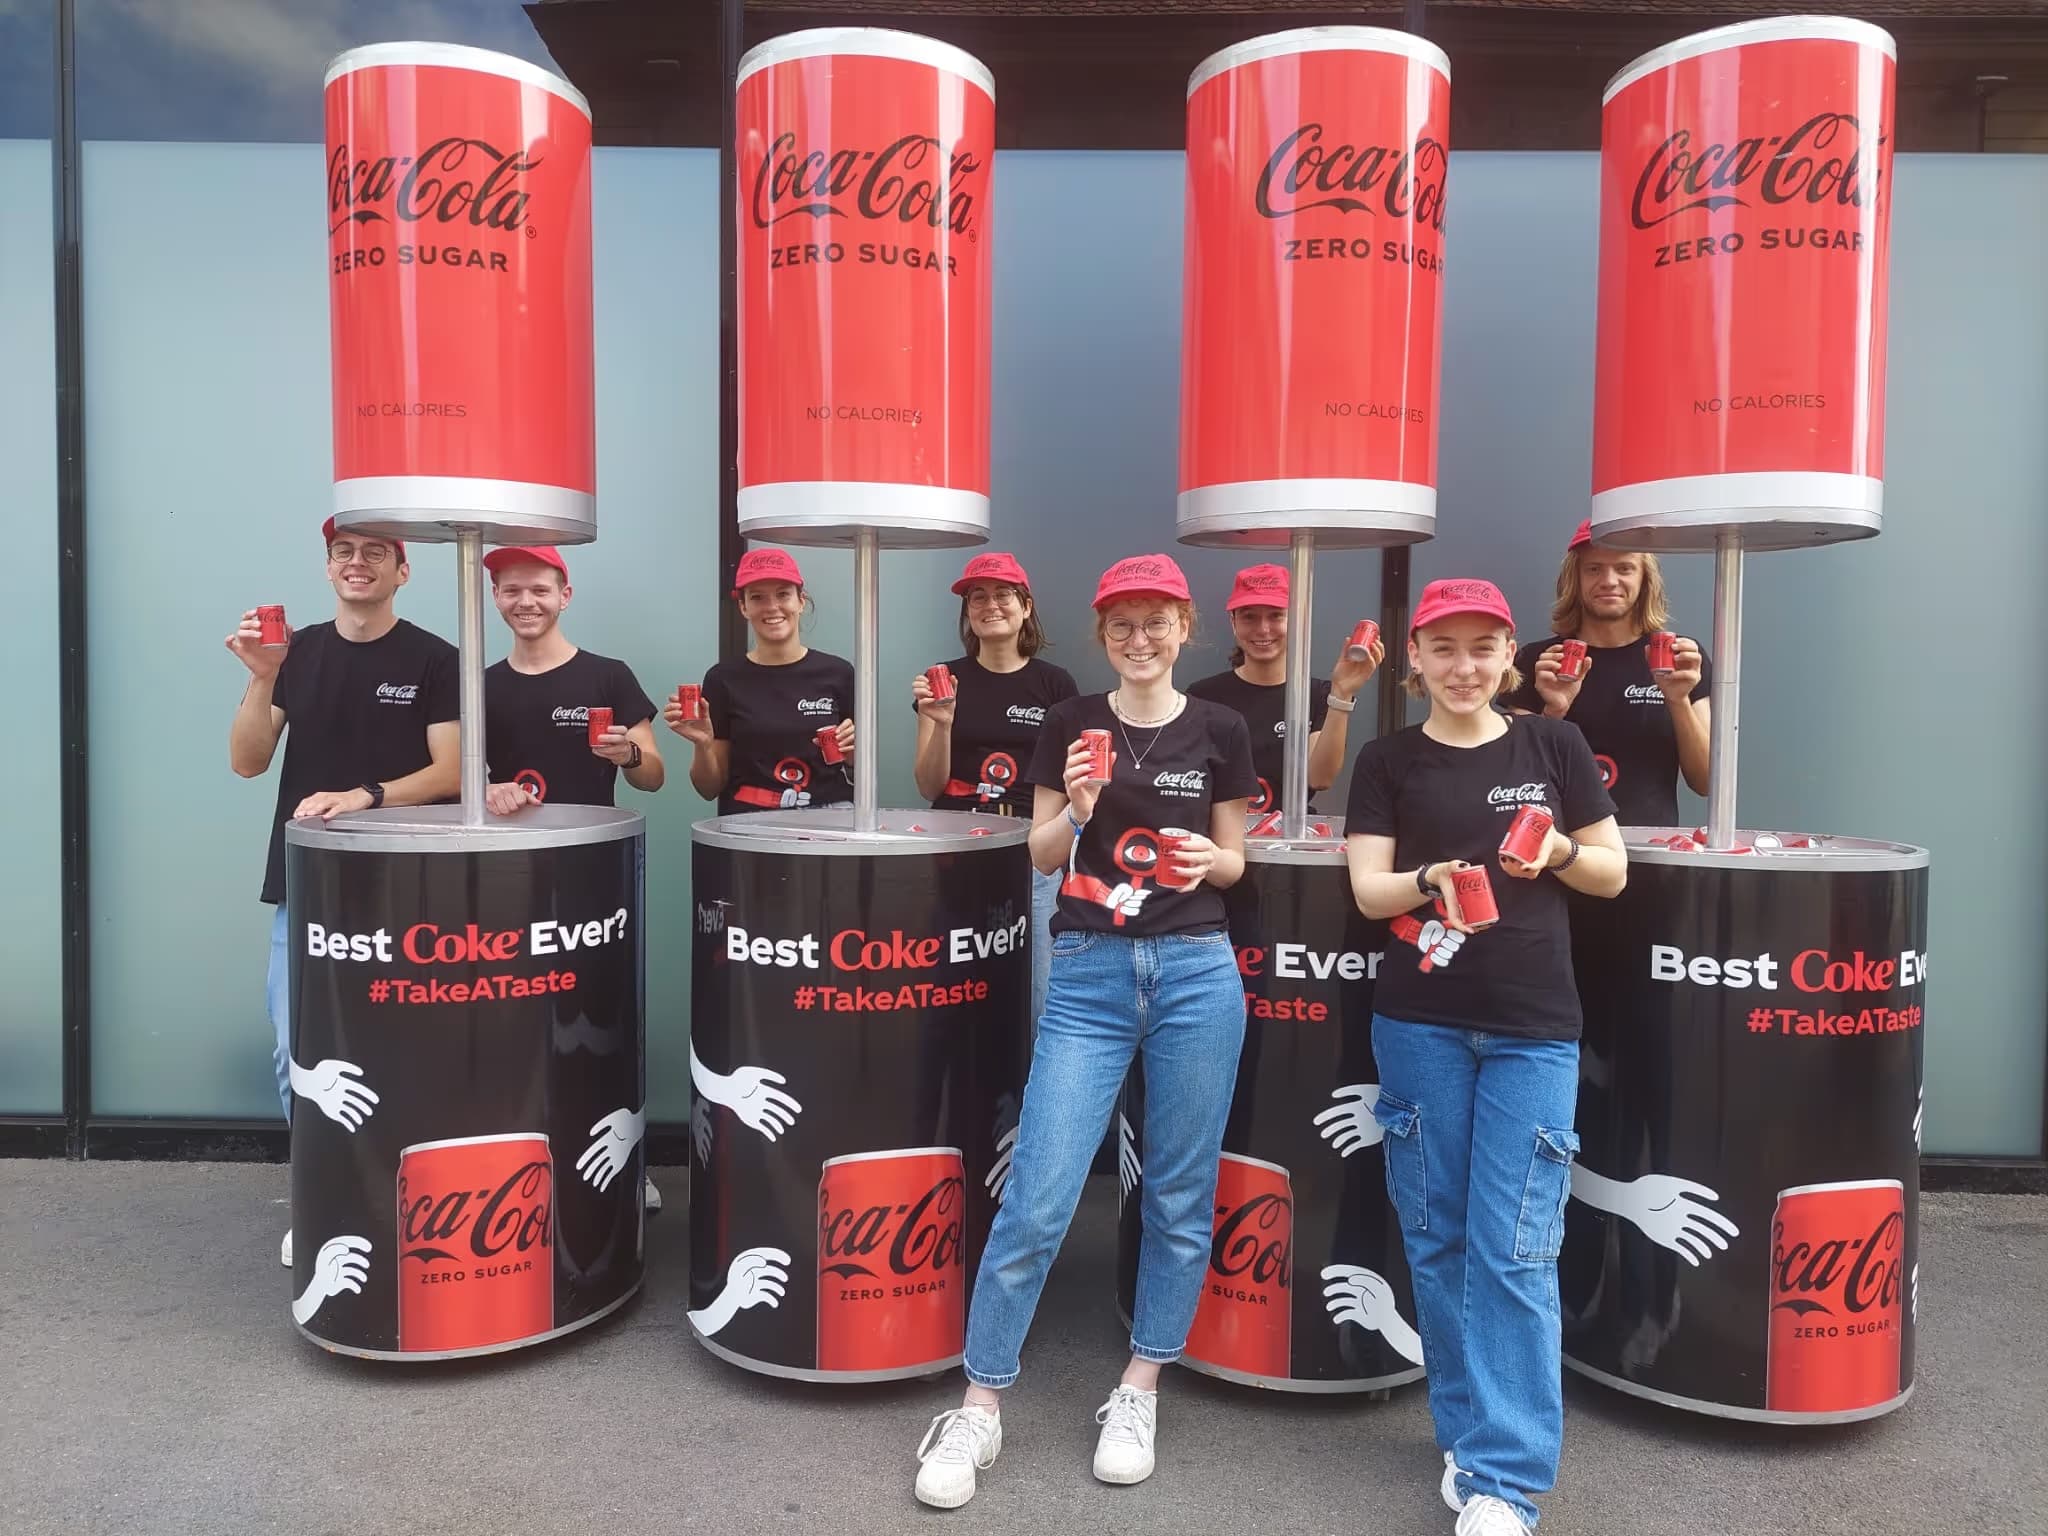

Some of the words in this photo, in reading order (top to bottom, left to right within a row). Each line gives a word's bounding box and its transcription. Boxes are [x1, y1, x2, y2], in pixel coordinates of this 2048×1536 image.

[328, 137, 544, 237] Coca-Cola
[753, 132, 979, 234] Coca-Cola
[1284, 238, 1370, 260] ZERO
[1654, 233, 1744, 268] ZERO
[1760, 228, 1864, 251] SUGAR
[334, 247, 386, 274] ZERO
[398, 245, 508, 272] SUGAR
[771, 243, 844, 268] ZERO
[859, 243, 957, 276] SUGAR
[358, 405, 377, 417] NO
[382, 403, 466, 418] CALORIES
[807, 406, 830, 421] NO
[837, 406, 922, 424] CALORIES
[1325, 402, 1351, 416] NO
[1357, 404, 1424, 424] CALORIES
[1693, 398, 1721, 414] NO
[1729, 394, 1825, 410] CALORIES
[1114, 561, 1163, 579] Coca-Cola
[376, 683, 419, 699] Coca-Cola
[798, 698, 834, 711] Coca-Cola
[1006, 705, 1046, 721] Coca-Cola
[1153, 770, 1207, 790] Coca-Cola
[1487, 783, 1547, 804] Coca-Cola
[1495, 804, 1516, 813] ZERO
[307, 922, 392, 963] Best
[402, 923, 522, 964] Coke
[530, 907, 627, 956] Ever?
[727, 926, 819, 969] Best
[830, 929, 942, 971] Coke
[949, 915, 1026, 964] Ever?
[1275, 942, 1385, 980] Ever
[1650, 944, 1778, 991] Best
[1790, 948, 1895, 992] Coke
[369, 970, 577, 1004] #TakeATaste
[794, 978, 988, 1013] #TakeATaste
[1746, 1004, 1921, 1037] #TakeATaste
[421, 1271, 465, 1284] ZERO
[475, 1260, 532, 1279] SUGAR
[840, 1288, 884, 1301] ZERO
[892, 1280, 946, 1297] SUGAR
[1212, 1285, 1268, 1306] SUGAR
[1793, 1326, 1839, 1339] ZERO
[1846, 1319, 1890, 1336] SUGAR
